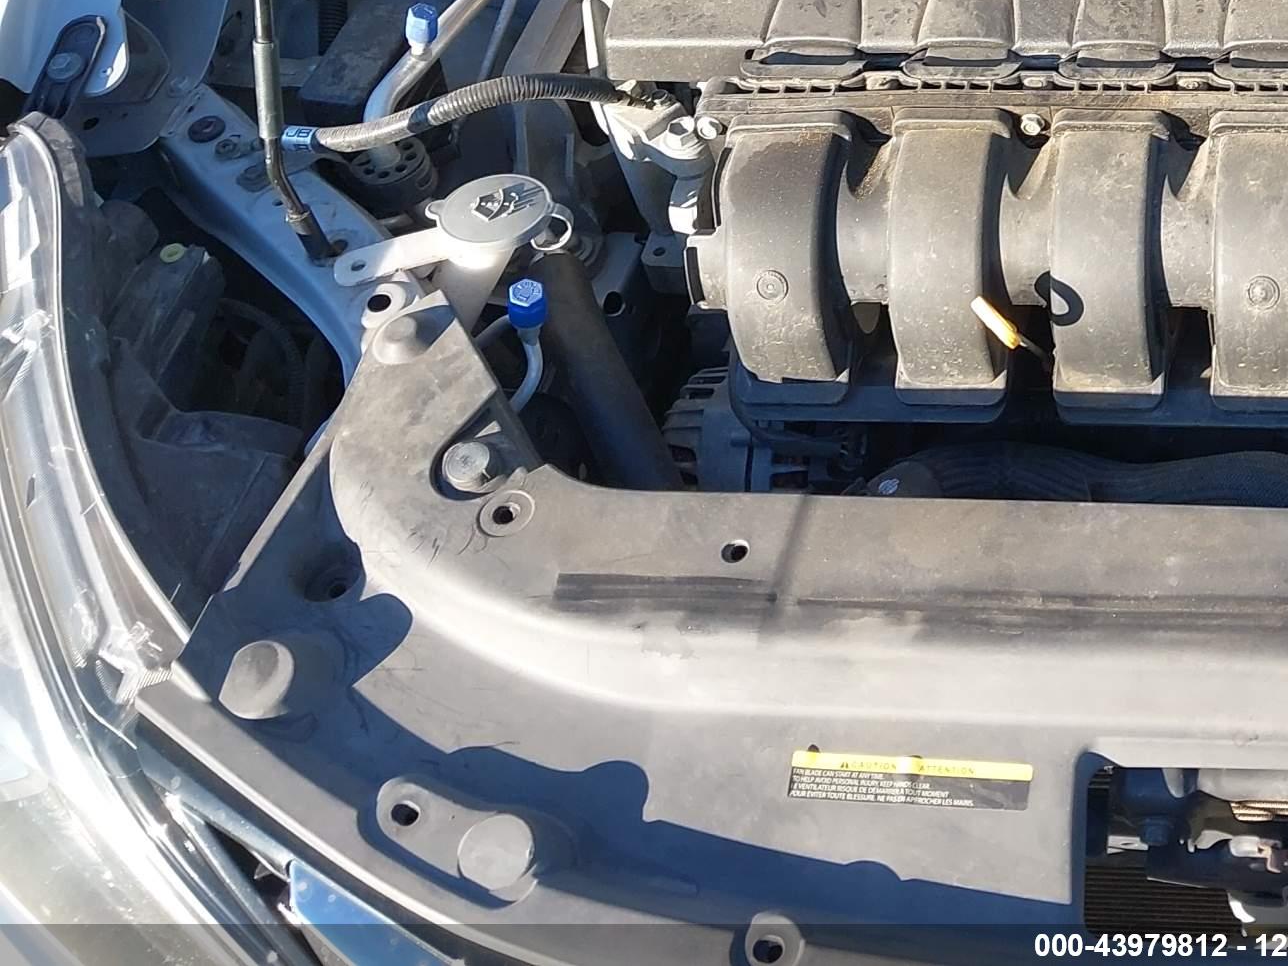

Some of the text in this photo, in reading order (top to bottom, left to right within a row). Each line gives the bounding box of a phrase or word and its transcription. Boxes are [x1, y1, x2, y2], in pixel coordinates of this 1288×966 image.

[851, 760, 973, 775] CAUTION ATTENTION
[832, 777, 858, 785] PERSONAL
[798, 782, 837, 791] VENTILATEUR
[838, 784, 858, 792] RISQUE
[905, 788, 920, 796] TOUT
[790, 789, 806, 797] POUR
[828, 791, 846, 799] TOUTE
[906, 796, 940, 805] APPROCHER
